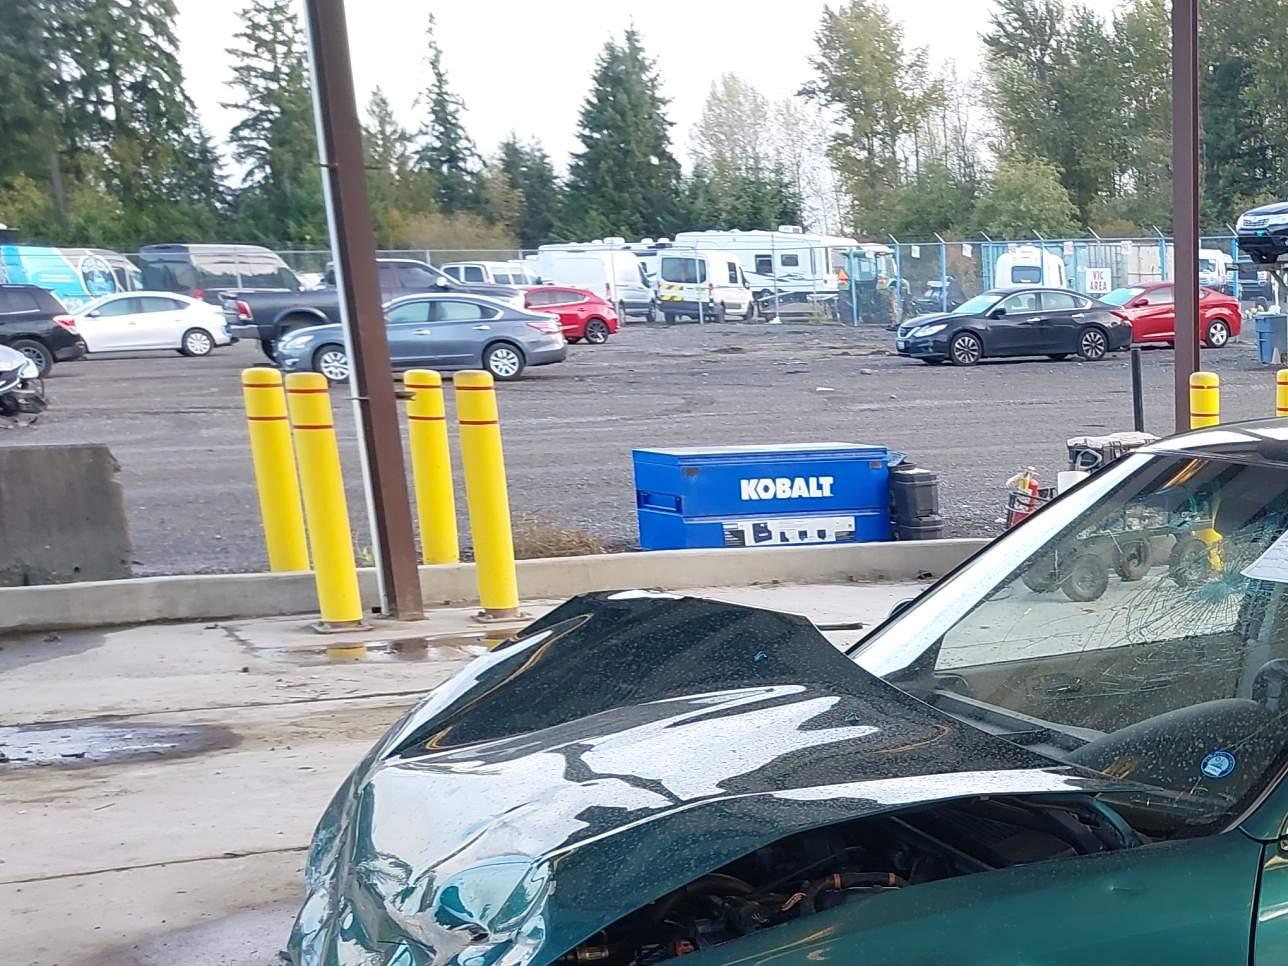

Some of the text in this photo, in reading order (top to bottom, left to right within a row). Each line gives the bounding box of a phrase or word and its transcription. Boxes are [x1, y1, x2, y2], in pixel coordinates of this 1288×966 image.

[1093, 271, 1104, 280] VIC
[1090, 281, 1107, 290] AREA
[740, 476, 834, 500] KOBALT
